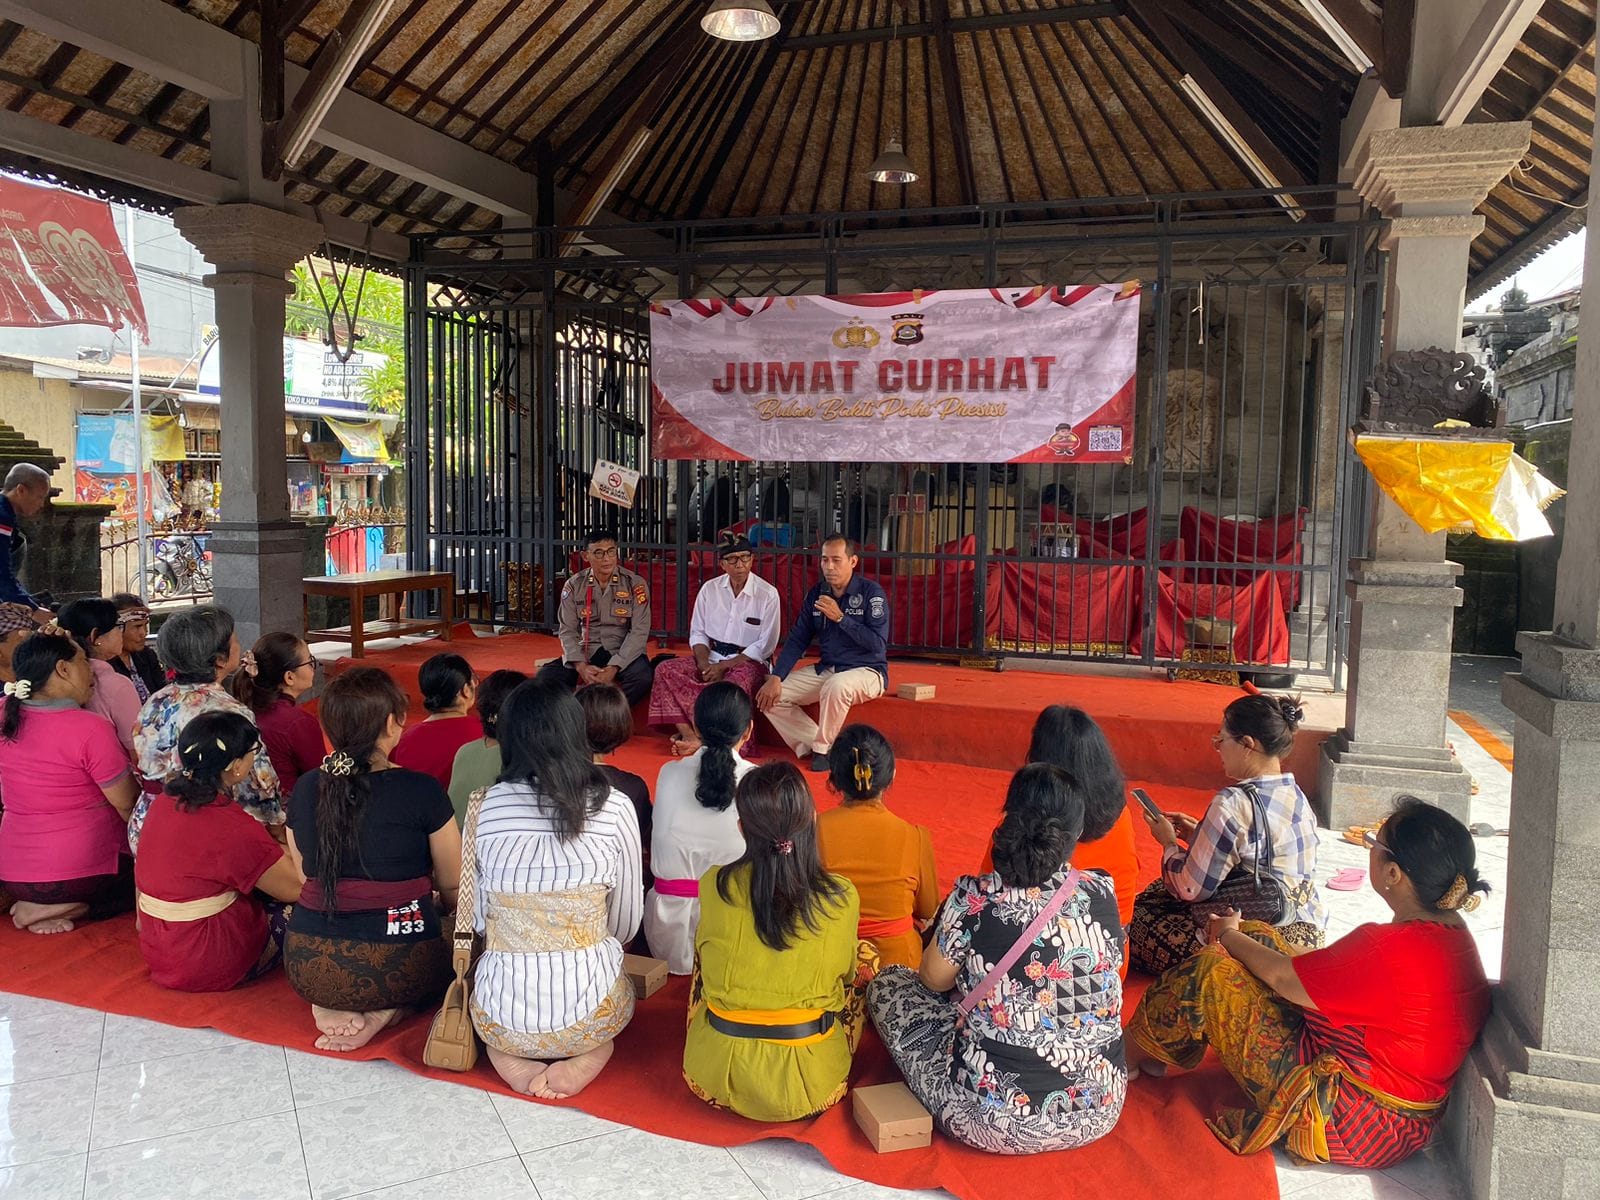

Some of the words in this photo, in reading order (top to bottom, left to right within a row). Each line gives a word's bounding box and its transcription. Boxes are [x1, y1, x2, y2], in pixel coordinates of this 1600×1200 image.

[324, 366, 333, 375] NO
[712, 360, 859, 394] JUMAT
[878, 355, 1056, 393] CURHAT
[756, 397, 816, 421] Bulan
[819, 395, 874, 421] Bakti
[877, 394, 930, 419] Polri
[934, 394, 1007, 419] Presisi
[845, 608, 864, 616] POLISI
[387, 919, 424, 936] N33
